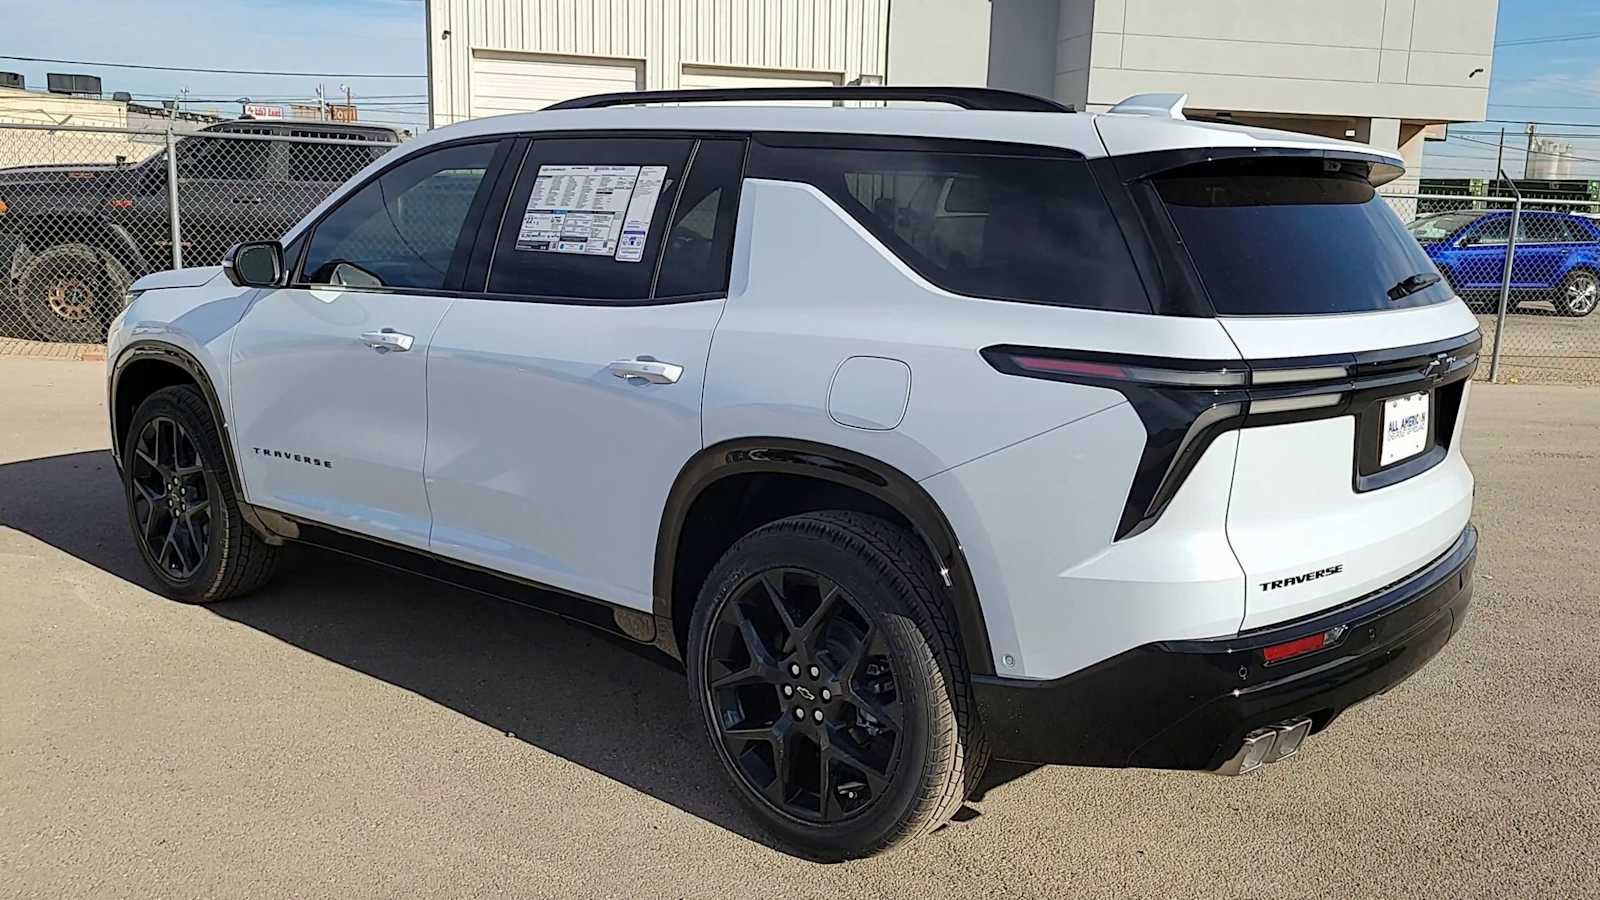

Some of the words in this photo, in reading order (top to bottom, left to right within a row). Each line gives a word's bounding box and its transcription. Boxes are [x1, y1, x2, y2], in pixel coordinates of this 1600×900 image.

[1401, 410, 1426, 431] AMERICN
[253, 446, 333, 469] TRAVERSE
[1259, 563, 1344, 592] TRAVERSE
